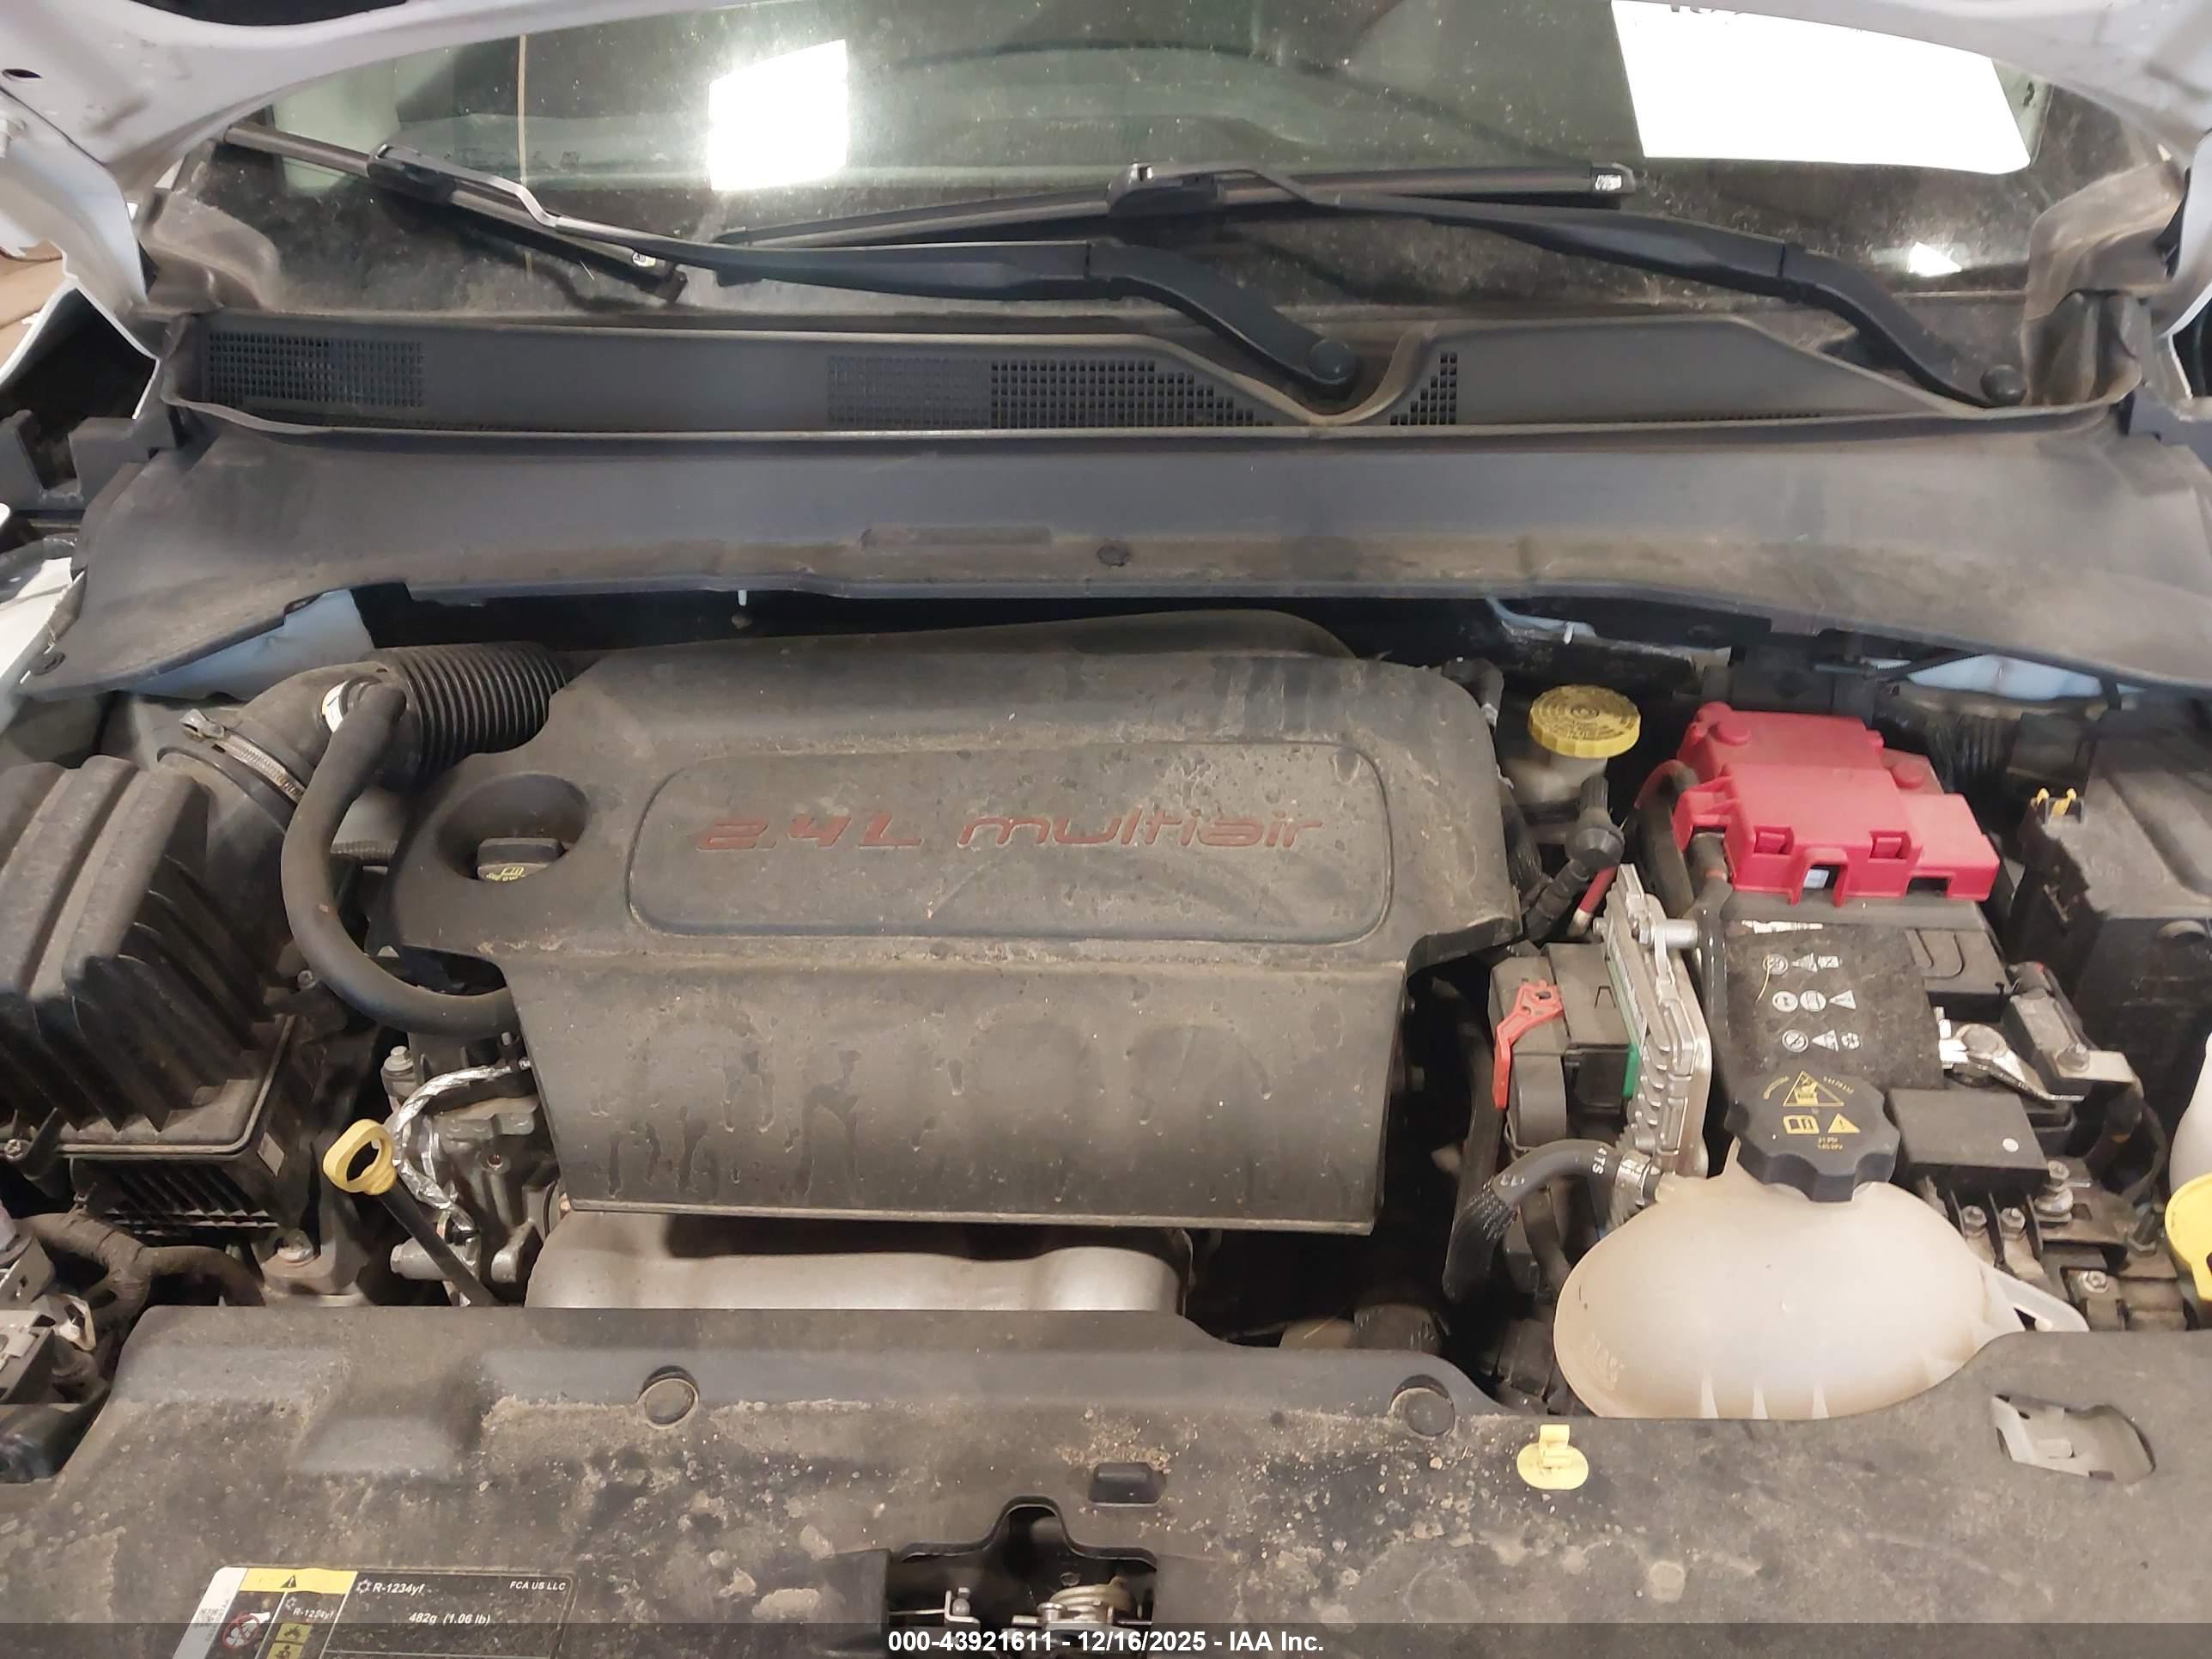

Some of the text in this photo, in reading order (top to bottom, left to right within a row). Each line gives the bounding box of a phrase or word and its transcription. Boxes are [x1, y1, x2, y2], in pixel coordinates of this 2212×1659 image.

[956, 803, 1324, 849] multiair
[372, 1582, 426, 1597] R-1234yf
[509, 1580, 530, 1590] FCA
[547, 1581, 567, 1591] LLC
[442, 1613, 474, 1626] (1.06
[474, 1613, 491, 1626] lb)
